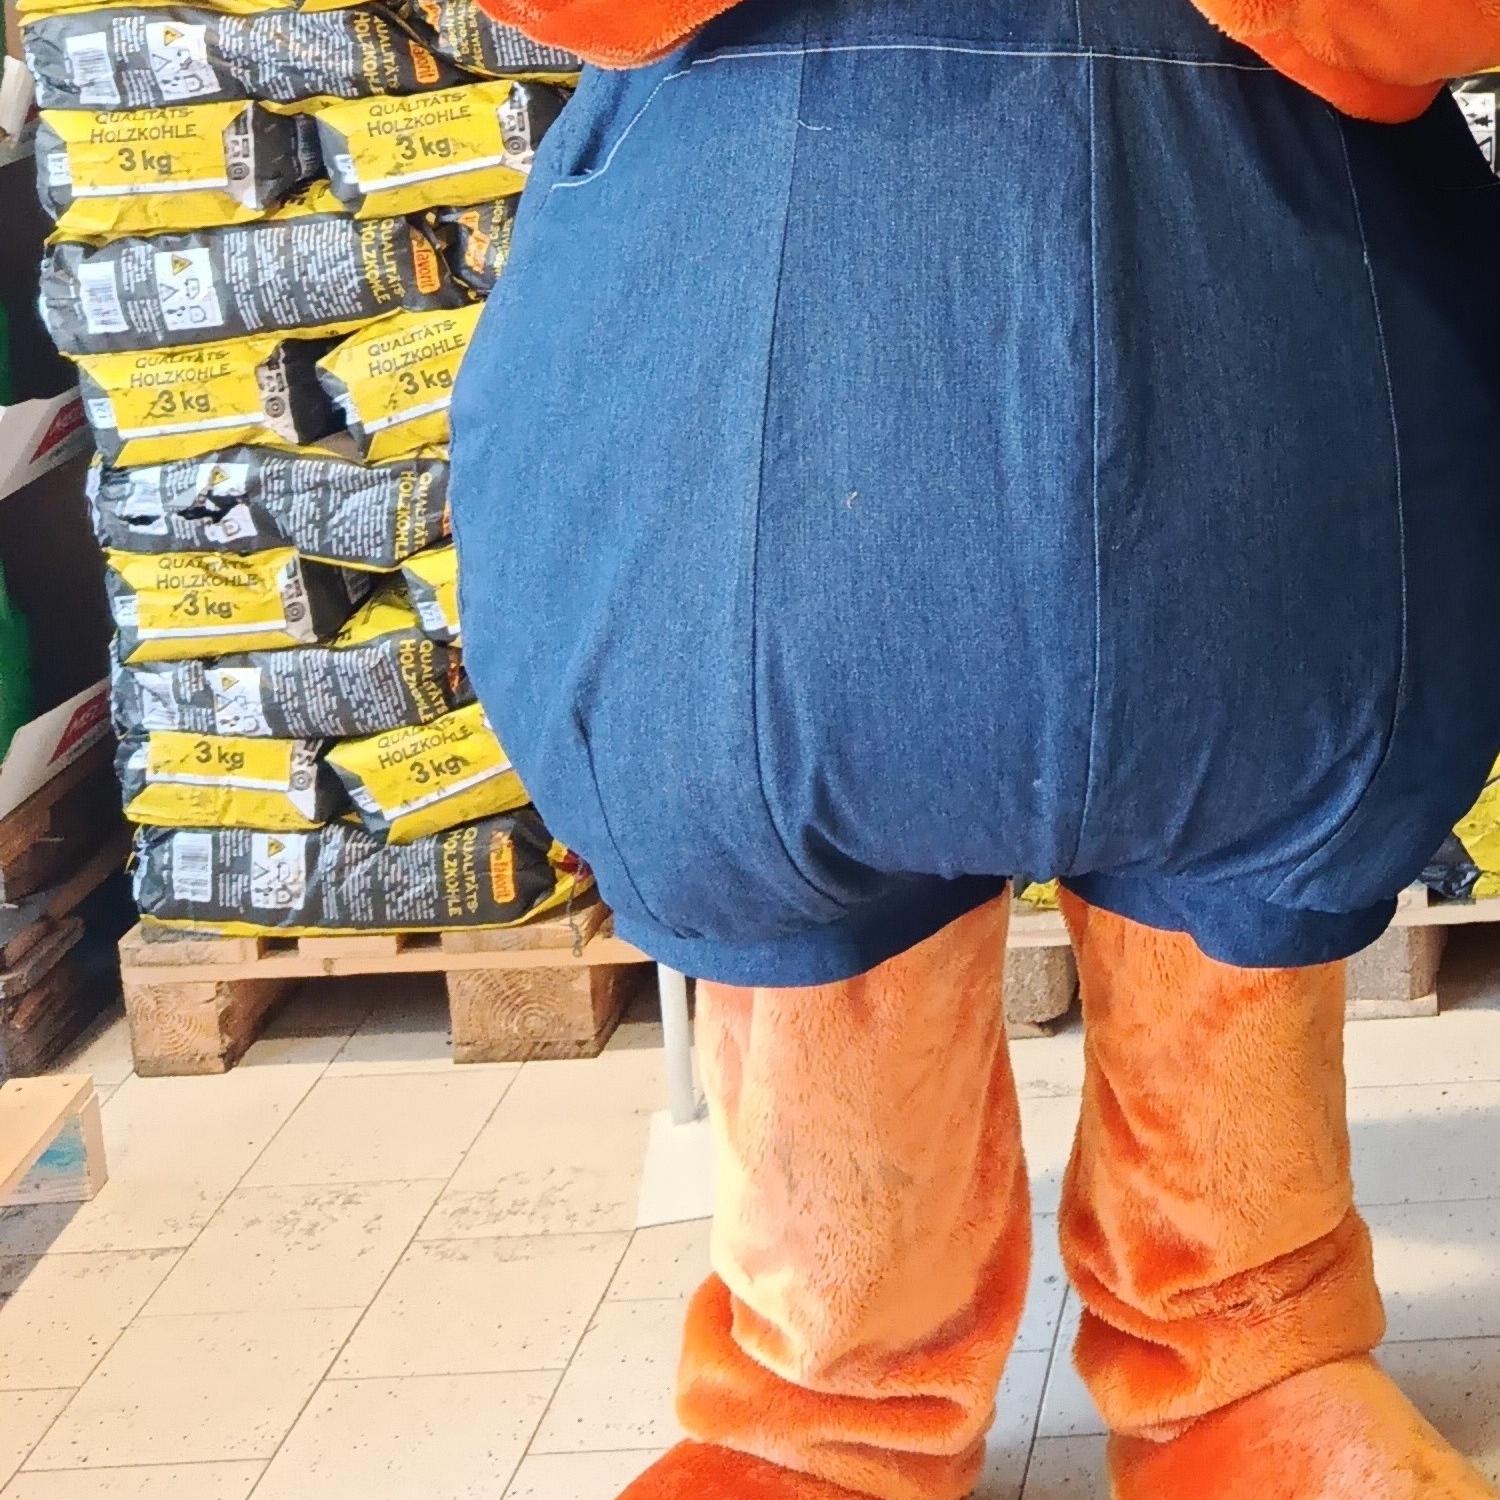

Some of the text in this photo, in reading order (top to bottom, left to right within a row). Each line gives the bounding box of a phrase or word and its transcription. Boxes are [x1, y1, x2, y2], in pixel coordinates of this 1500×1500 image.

[369, 92, 467, 117] QUALITÄTS-
[90, 124, 197, 144] HOLZKOHLE
[367, 105, 472, 137] HOLZKOHLE
[118, 148, 173, 175] 3 kg
[396, 136, 451, 160] 3 kg
[360, 219, 391, 304] HOLZKOHLE
[368, 319, 457, 357] QUALITÄTS-
[369, 333, 466, 378] HOLZKOHLE
[130, 364, 232, 389] HOLZKOHLE
[400, 367, 453, 395] 3 kg
[157, 390, 211, 413] 3 kg
[394, 470, 416, 560] HOLZKOHLE
[156, 572, 258, 589] HOLZKOHLE
[183, 594, 233, 618] 3 kg
[400, 639, 434, 722] HOLZKOHLE
[194, 741, 245, 770] 3 kg
[378, 725, 473, 770] HOLZKOHLE
[410, 754, 463, 783] 3 kg
[443, 831, 463, 917] HOLZKOHLE
